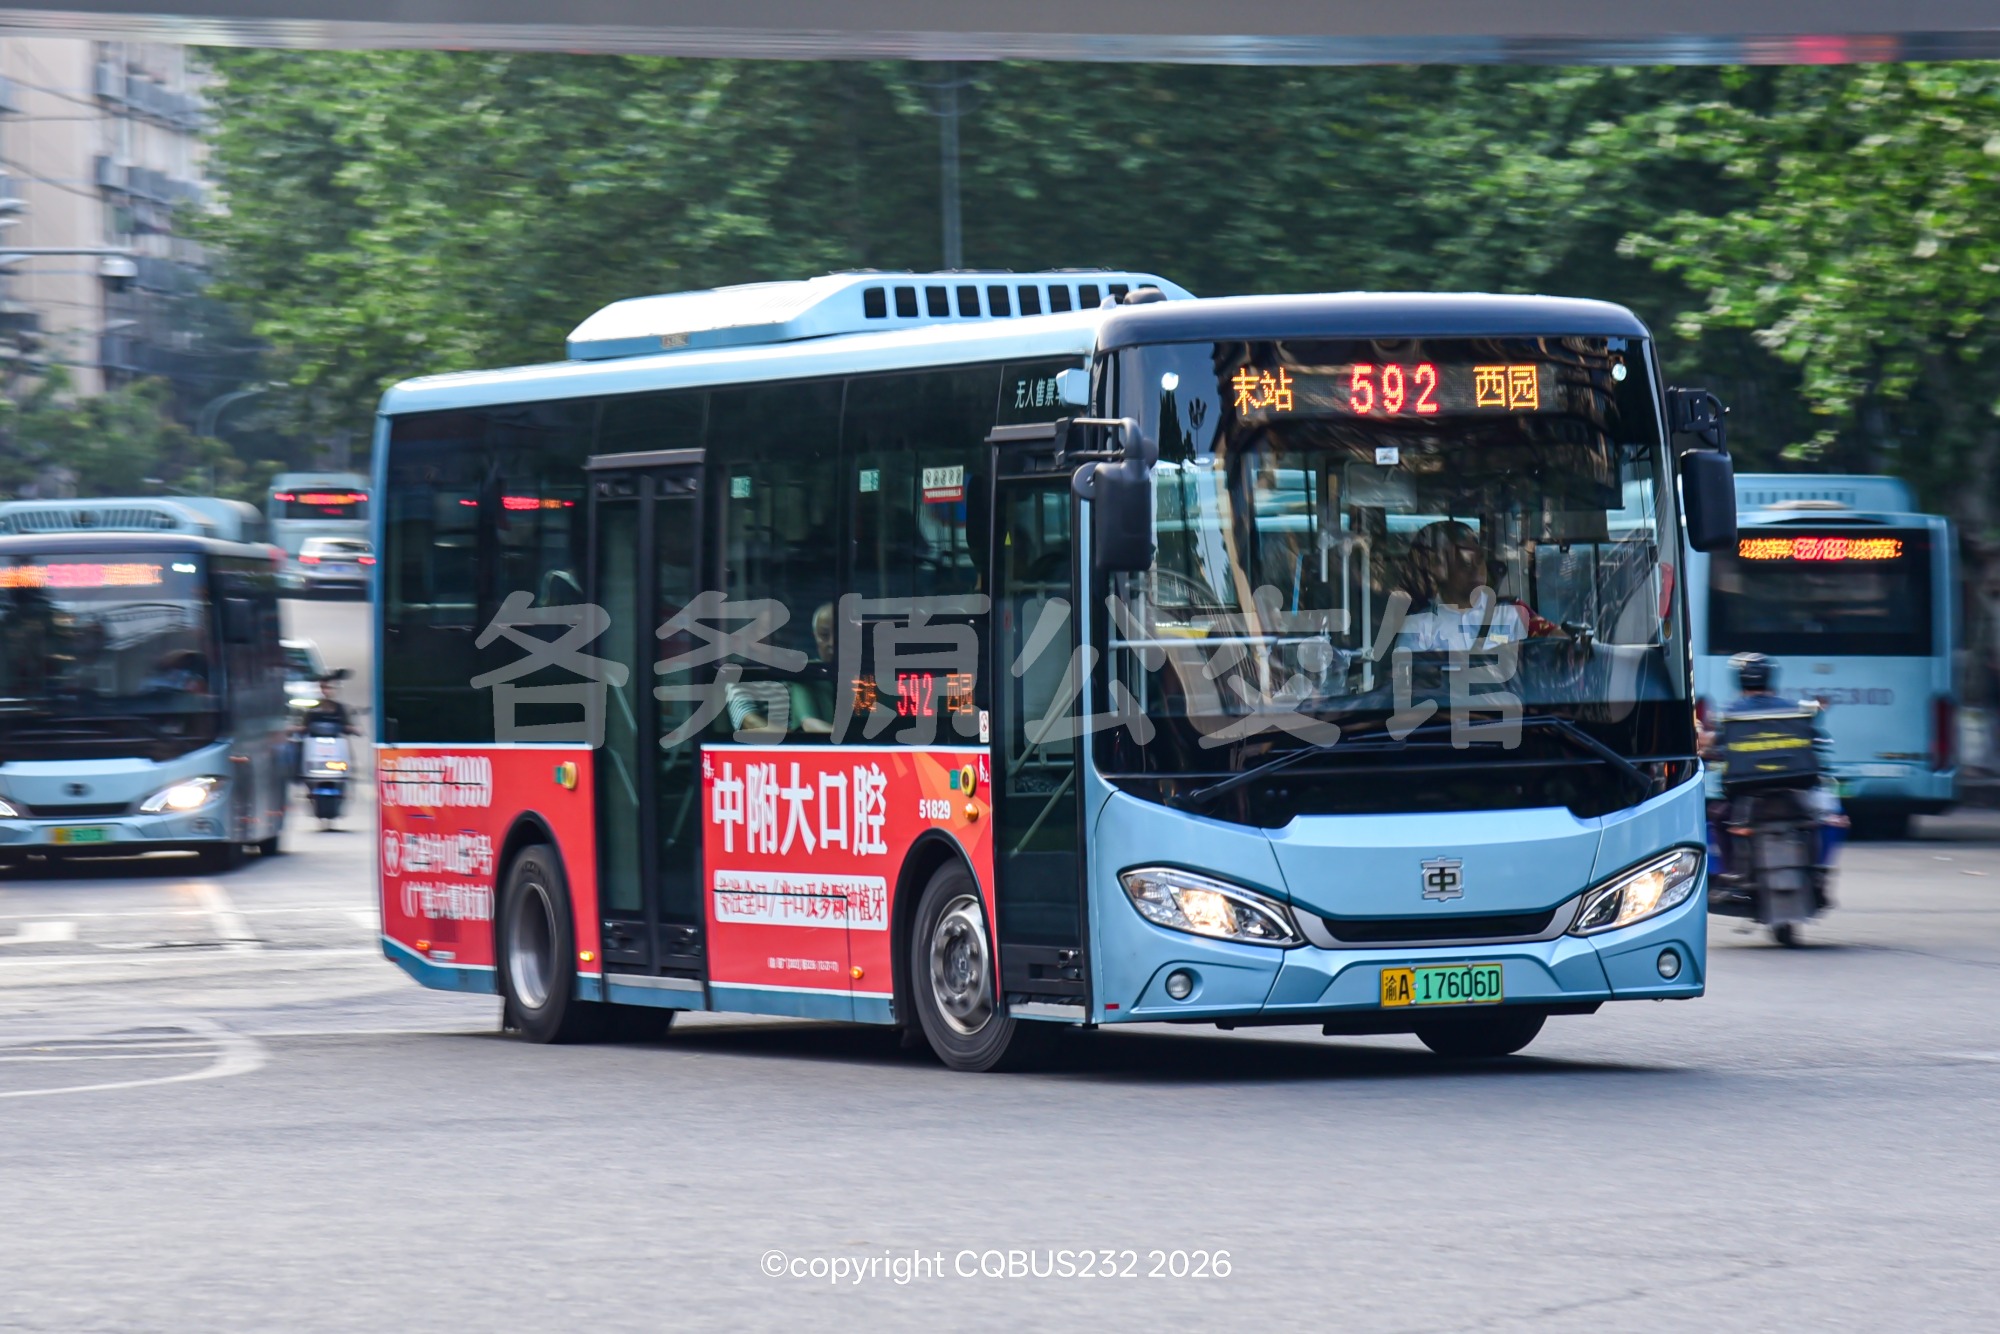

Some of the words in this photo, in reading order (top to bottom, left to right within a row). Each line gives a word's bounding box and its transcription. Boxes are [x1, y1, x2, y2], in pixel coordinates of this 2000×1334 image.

[1231, 367, 1293, 415] 末站
[1350, 364, 1439, 413] 592
[1473, 365, 1538, 411] 西园
[896, 672, 934, 716] 592
[712, 762, 888, 856] 中附大口腔
[919, 799, 951, 820] 51829
